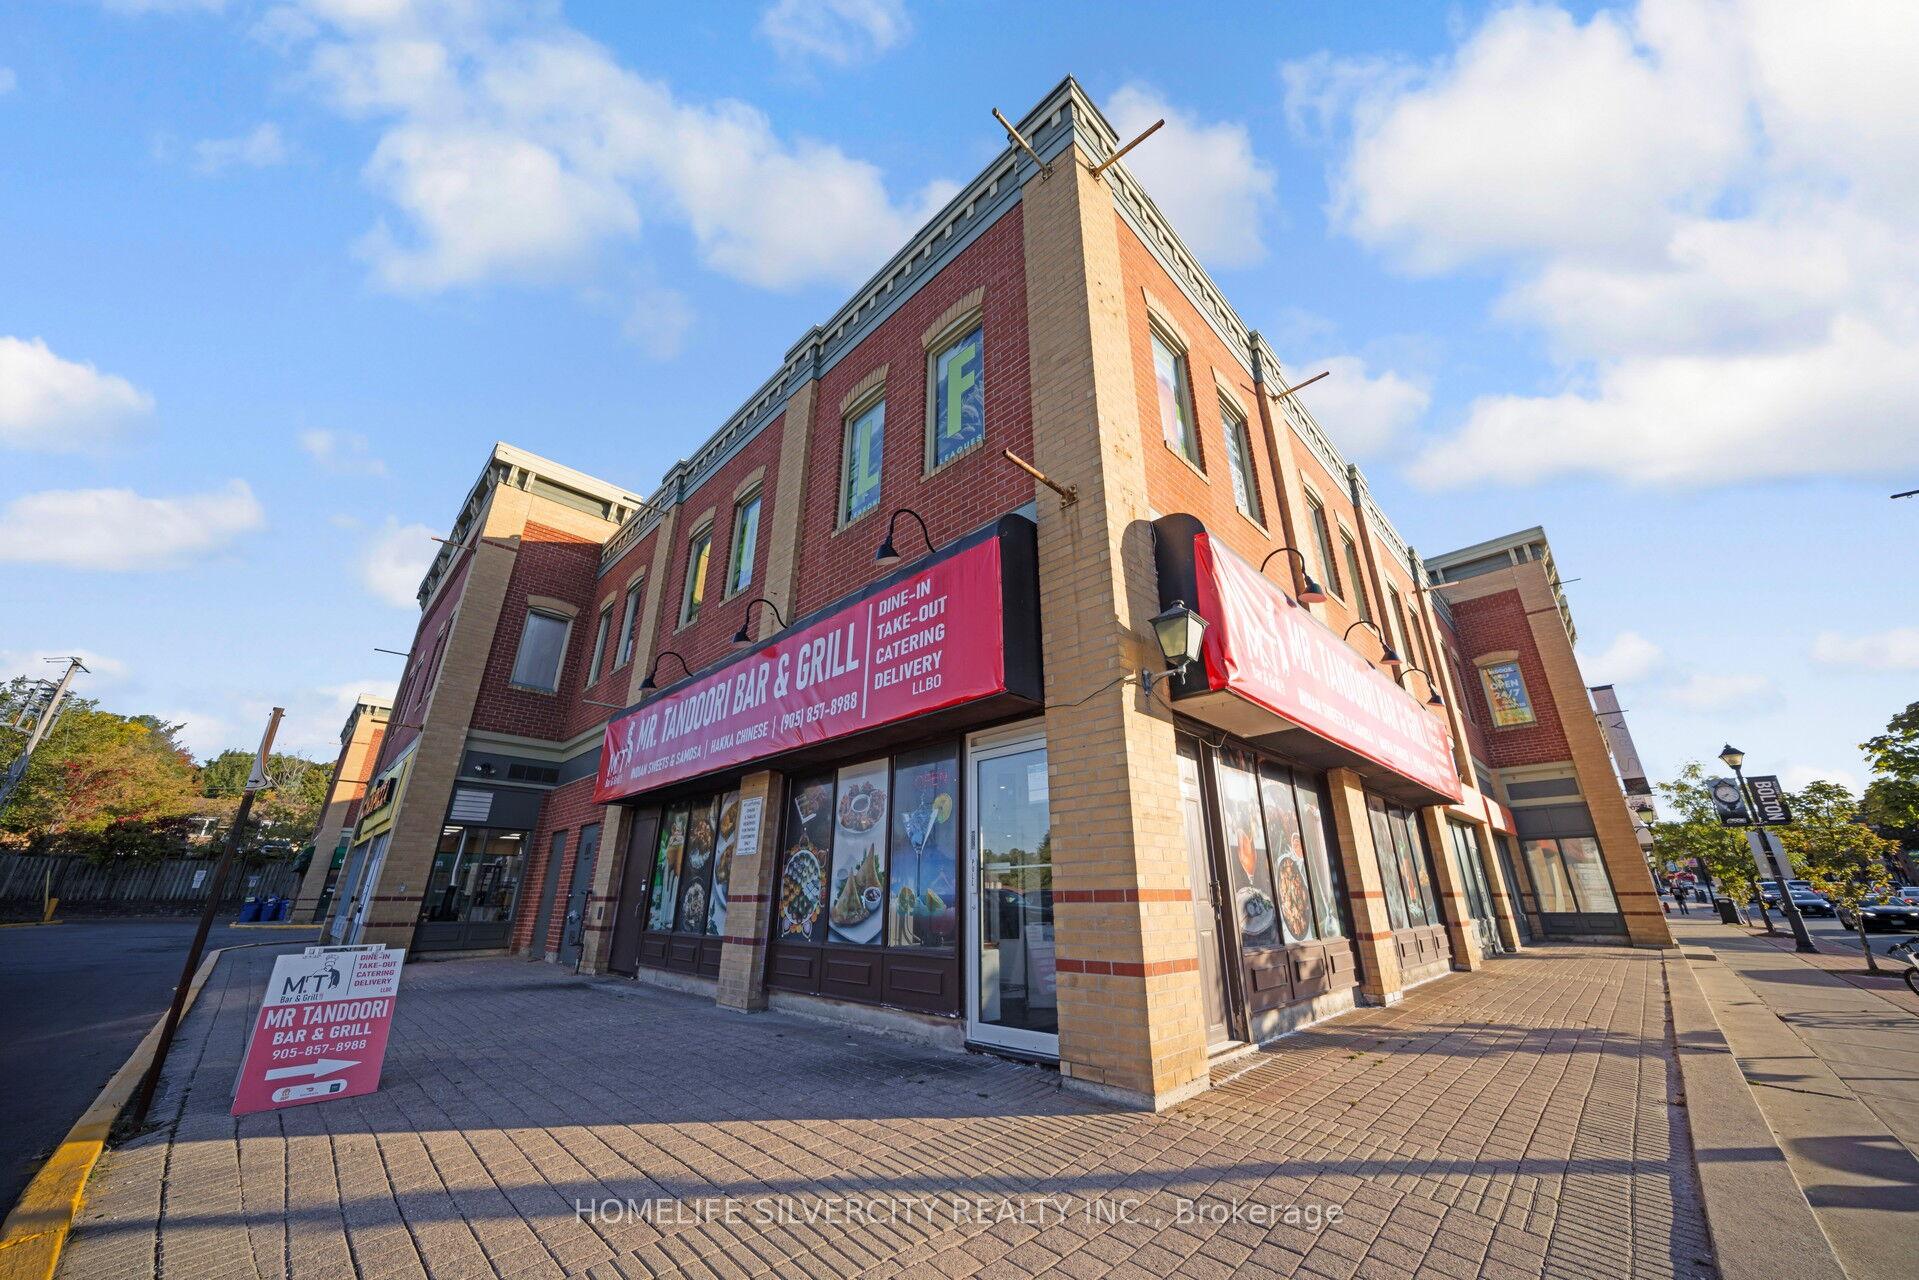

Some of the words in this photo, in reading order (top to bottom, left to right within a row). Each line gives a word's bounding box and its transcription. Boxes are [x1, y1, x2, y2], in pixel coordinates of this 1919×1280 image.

[947, 342, 976, 438] F
[857, 419, 880, 497] L
[939, 433, 983, 465] LEAGUES
[878, 578, 931, 617] DINE-IN
[876, 595, 948, 640] TAKE-OUT
[875, 622, 945, 665] CATERING
[874, 650, 943, 690] DELIVERY
[912, 673, 942, 696] LLBO
[636, 713, 658, 752] MR.
[661, 678, 732, 744] TANDOORI
[733, 662, 770, 715] BAR
[774, 653, 790, 699] &
[796, 622, 860, 691] GRILL
[648, 755, 670, 774] SWEETS
[675, 744, 702, 765] SAMOSA
[710, 735, 734, 754] HAKKA
[735, 721, 769, 746] CHINESE
[780, 708, 804, 734] (905)
[806, 691, 858, 722] 857-8988
[1754, 780, 1786, 821] BOLTON
[358, 961, 397, 969] TAKE-OUT
[360, 953, 391, 961] DINE-IN
[354, 978, 392, 987] DELIVERY
[356, 969, 395, 978] CATERING
[263, 1007, 297, 1030] MR
[302, 999, 390, 1026] TANDOORI
[280, 995, 293, 1004] Bar
[303, 993, 319, 1002] Grill
[272, 1029, 307, 1045] BAR
[311, 1027, 324, 1040] &
[329, 1022, 372, 1039] GRILL
[272, 1039, 367, 1060] 905-857-8988
